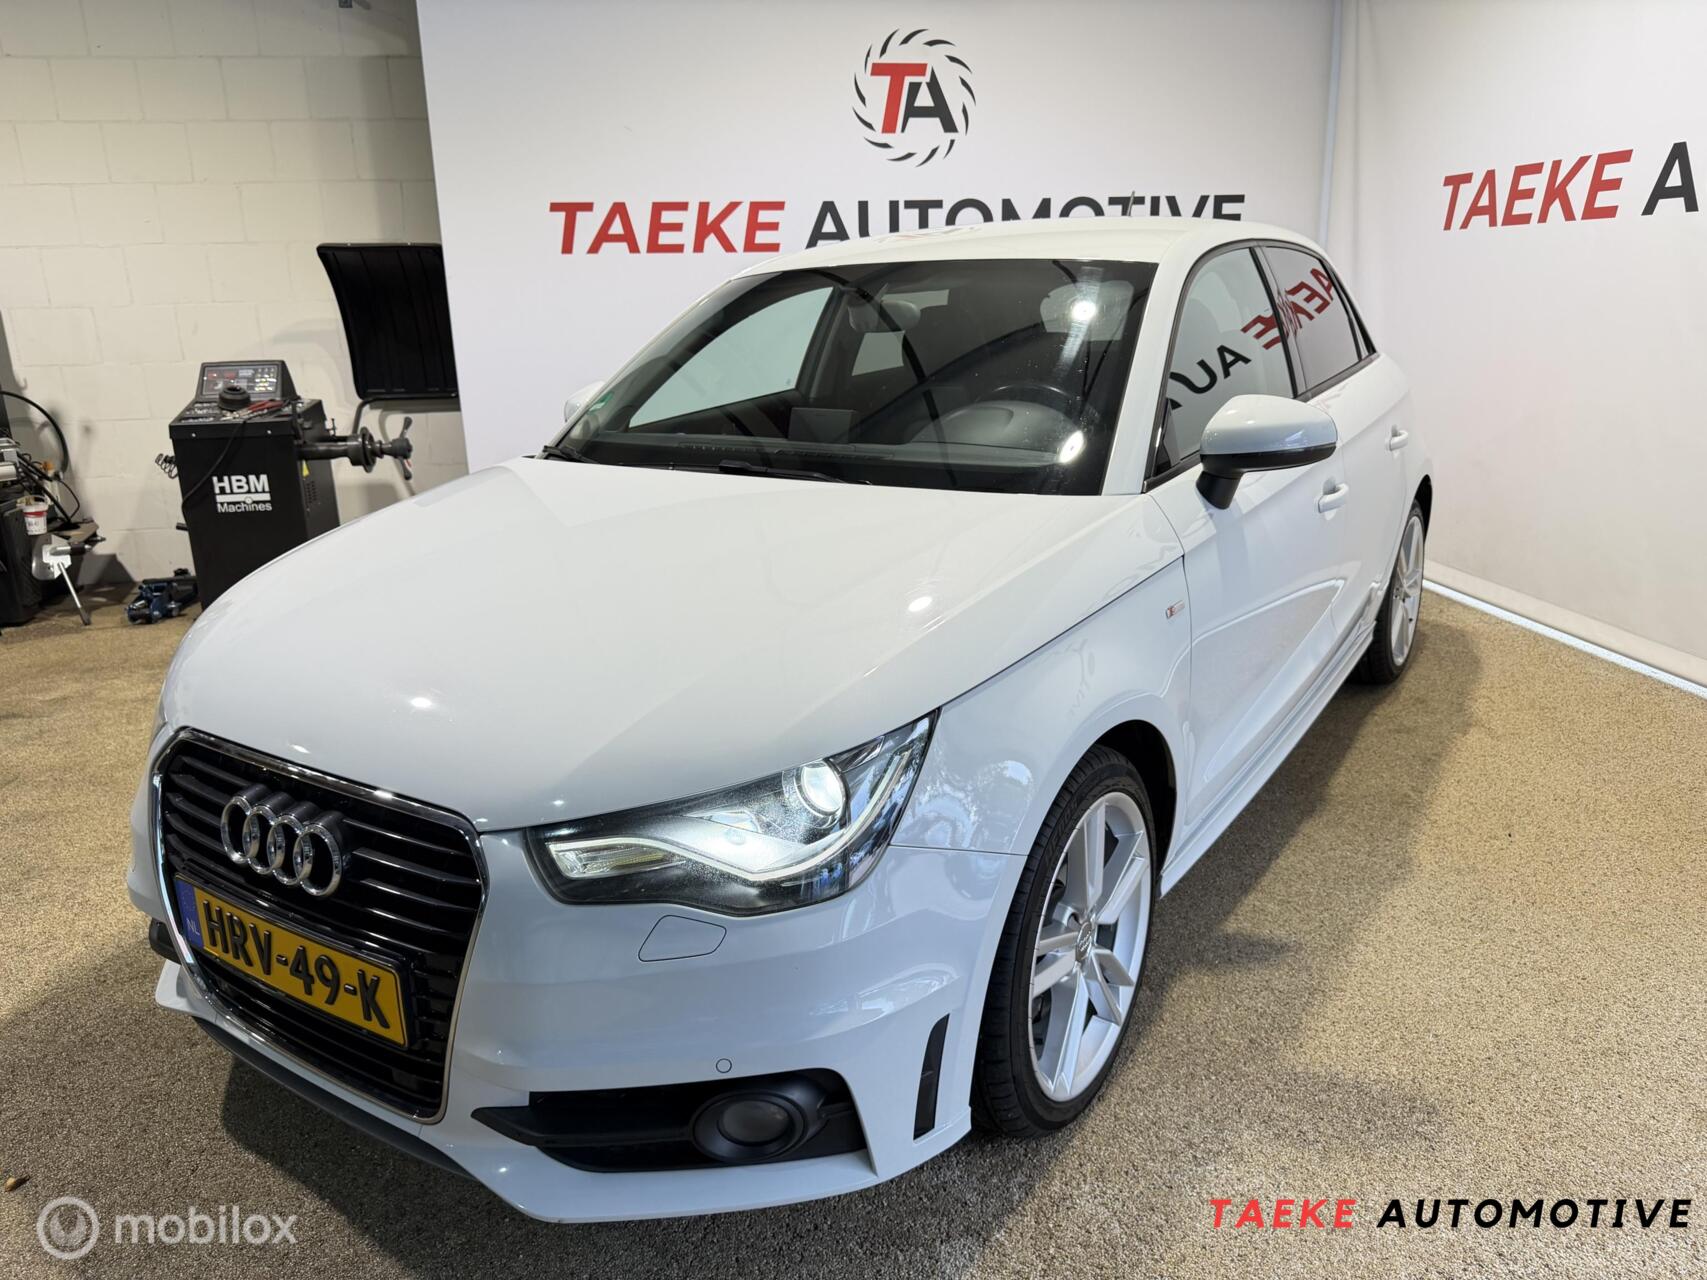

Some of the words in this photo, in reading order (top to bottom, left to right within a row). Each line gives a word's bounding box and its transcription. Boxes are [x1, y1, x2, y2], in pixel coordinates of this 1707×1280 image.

[870, 63, 959, 133] TA
[1442, 148, 1634, 232] TAEKE
[548, 201, 787, 255] TAEKE
[211, 474, 270, 494] HBM
[216, 502, 273, 513] Machines
[185, 916, 201, 936] NL
[202, 899, 391, 1030] HRV-49-K
